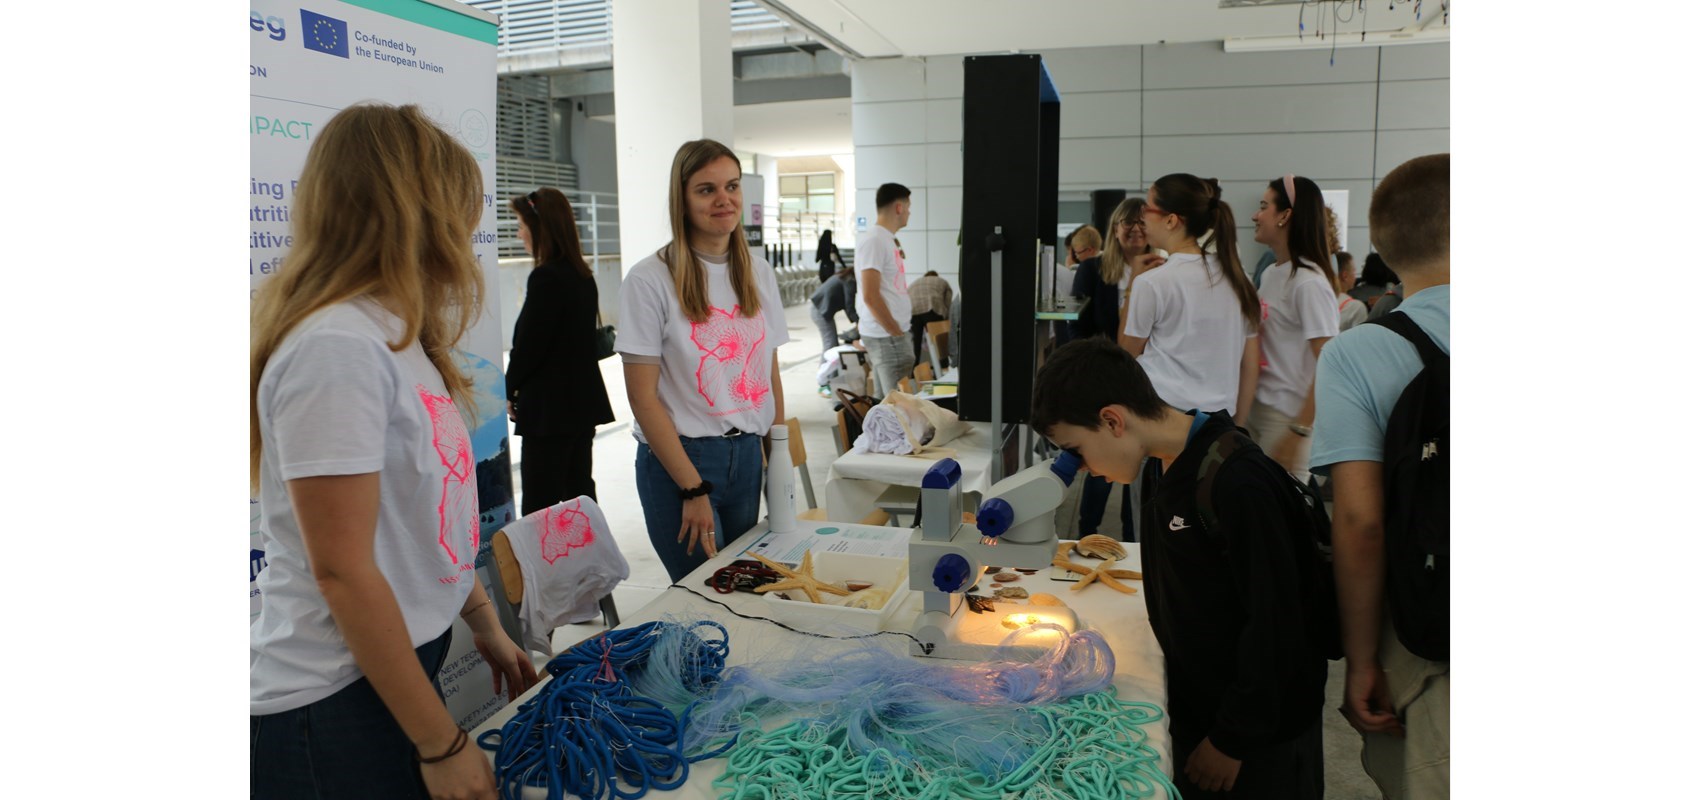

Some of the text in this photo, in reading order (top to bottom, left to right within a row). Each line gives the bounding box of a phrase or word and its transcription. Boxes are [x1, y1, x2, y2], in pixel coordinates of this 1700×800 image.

[355, 30, 417, 55] Co-funded by
[355, 45, 444, 74] the European Union
[250, 115, 313, 140] PACT
[250, 178, 284, 200] ing
[250, 205, 291, 222] triti
[440, 659, 459, 676] NEW
[456, 707, 481, 727] AFETY
